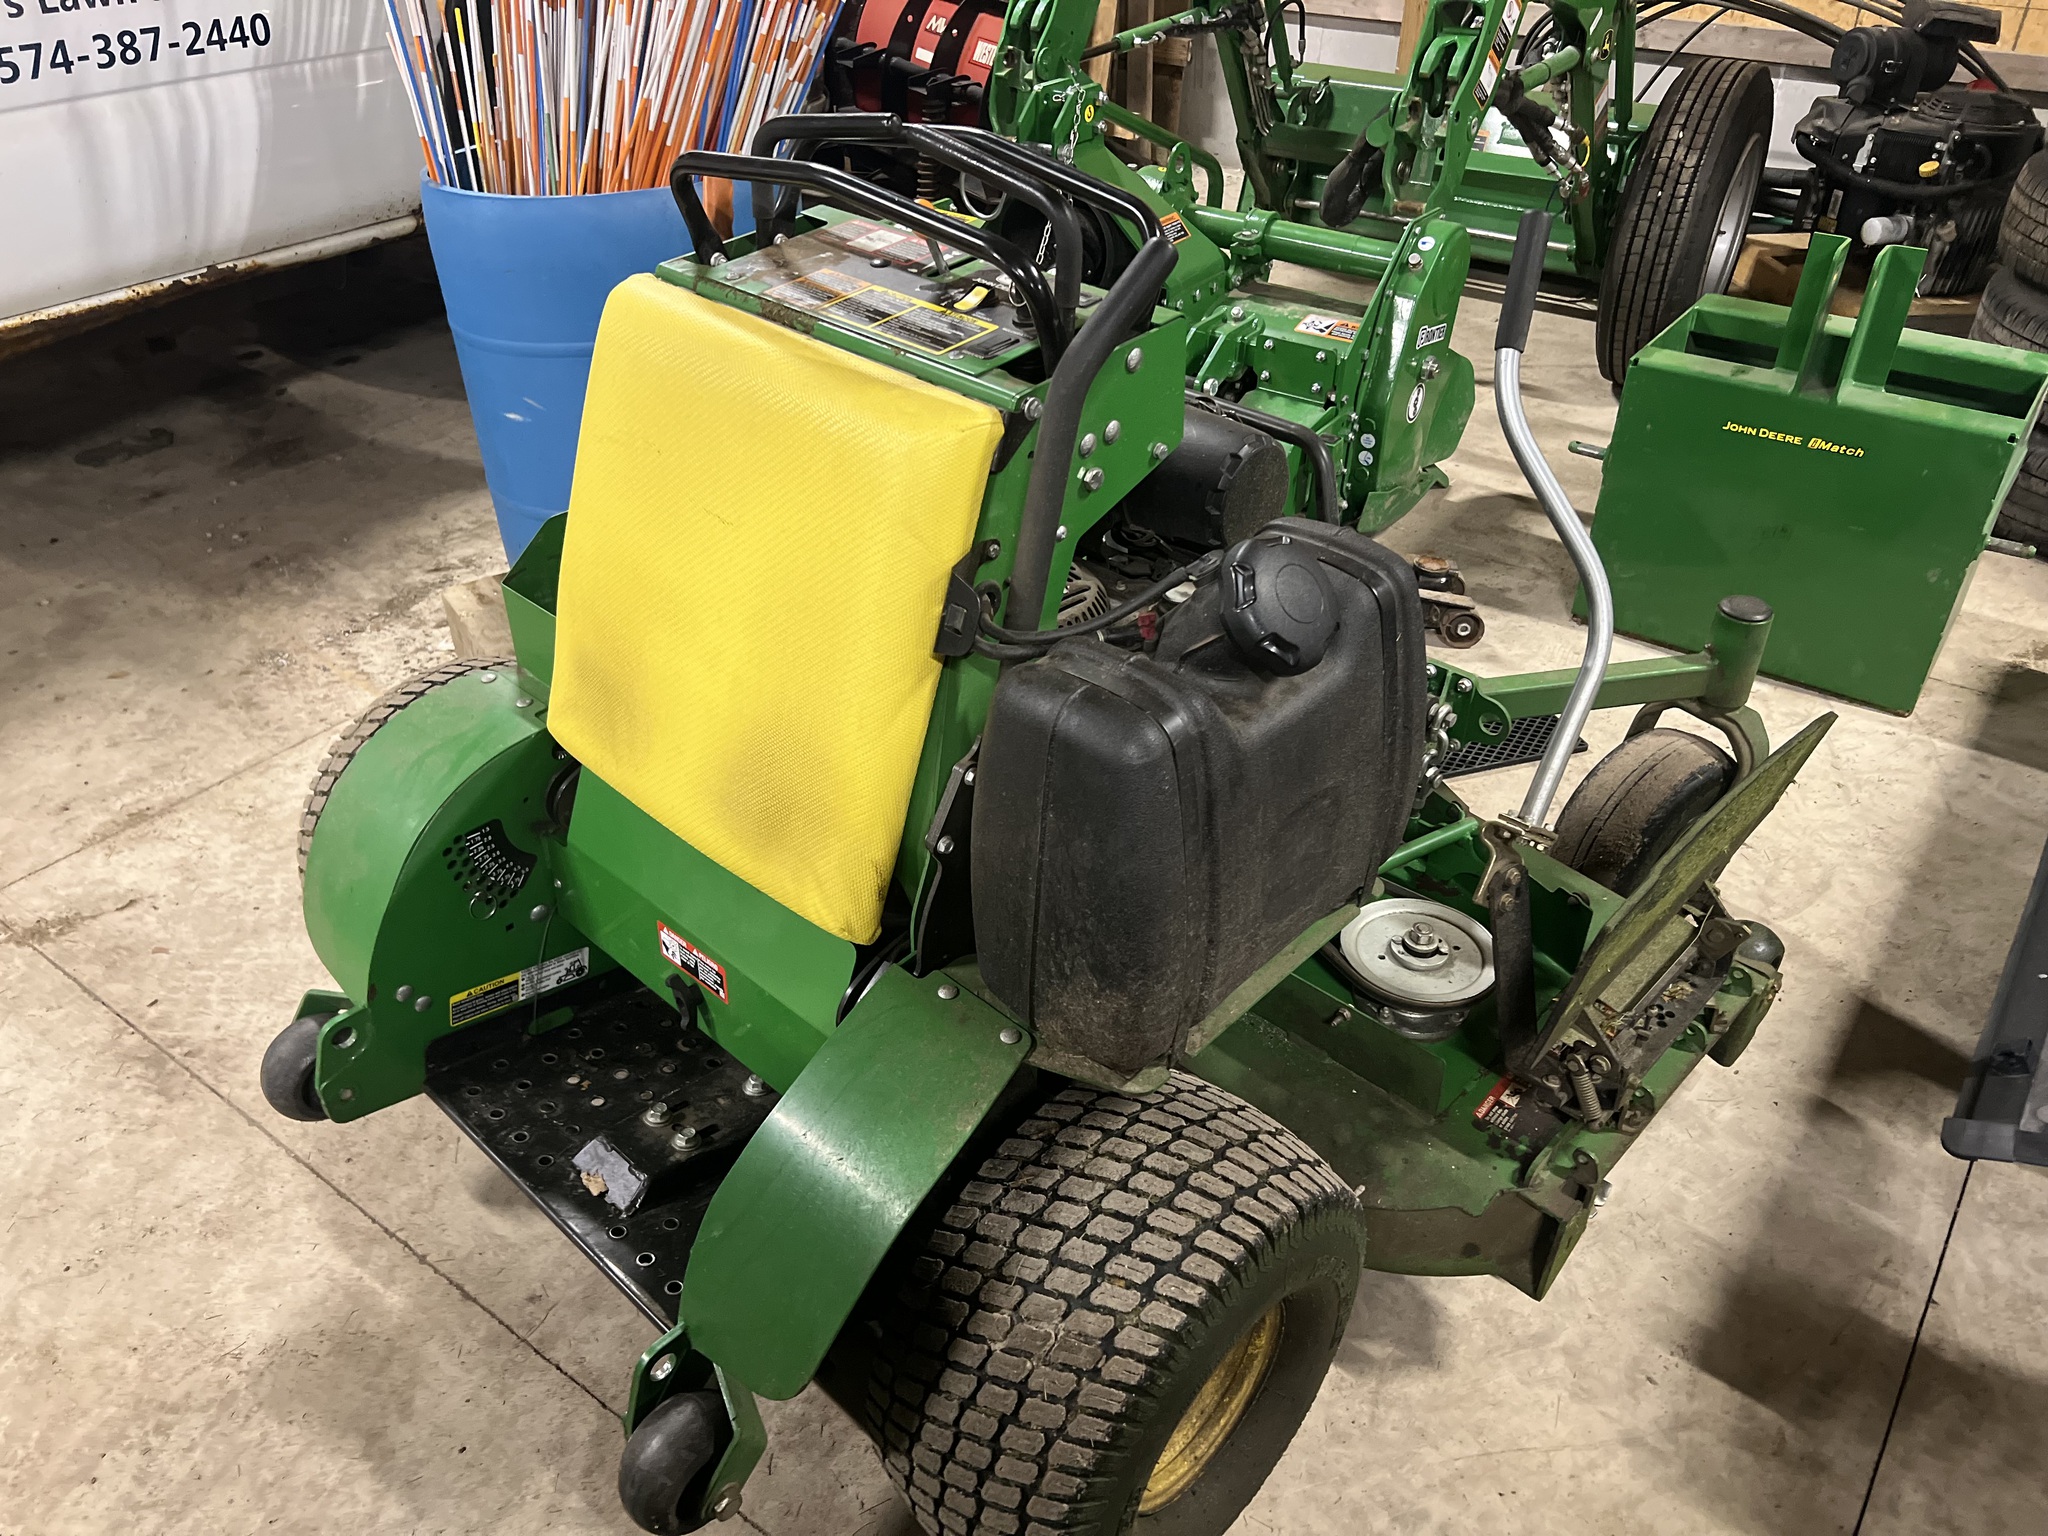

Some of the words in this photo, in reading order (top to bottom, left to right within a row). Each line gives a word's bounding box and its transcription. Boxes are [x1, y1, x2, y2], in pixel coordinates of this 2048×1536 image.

[0, 13, 271, 84] 574-387-2440
[1722, 421, 1757, 436] JOHN
[1758, 428, 1803, 445] DEERE
[473, 979, 505, 996] CAUTION
[1477, 1095, 1497, 1114] DANGER
